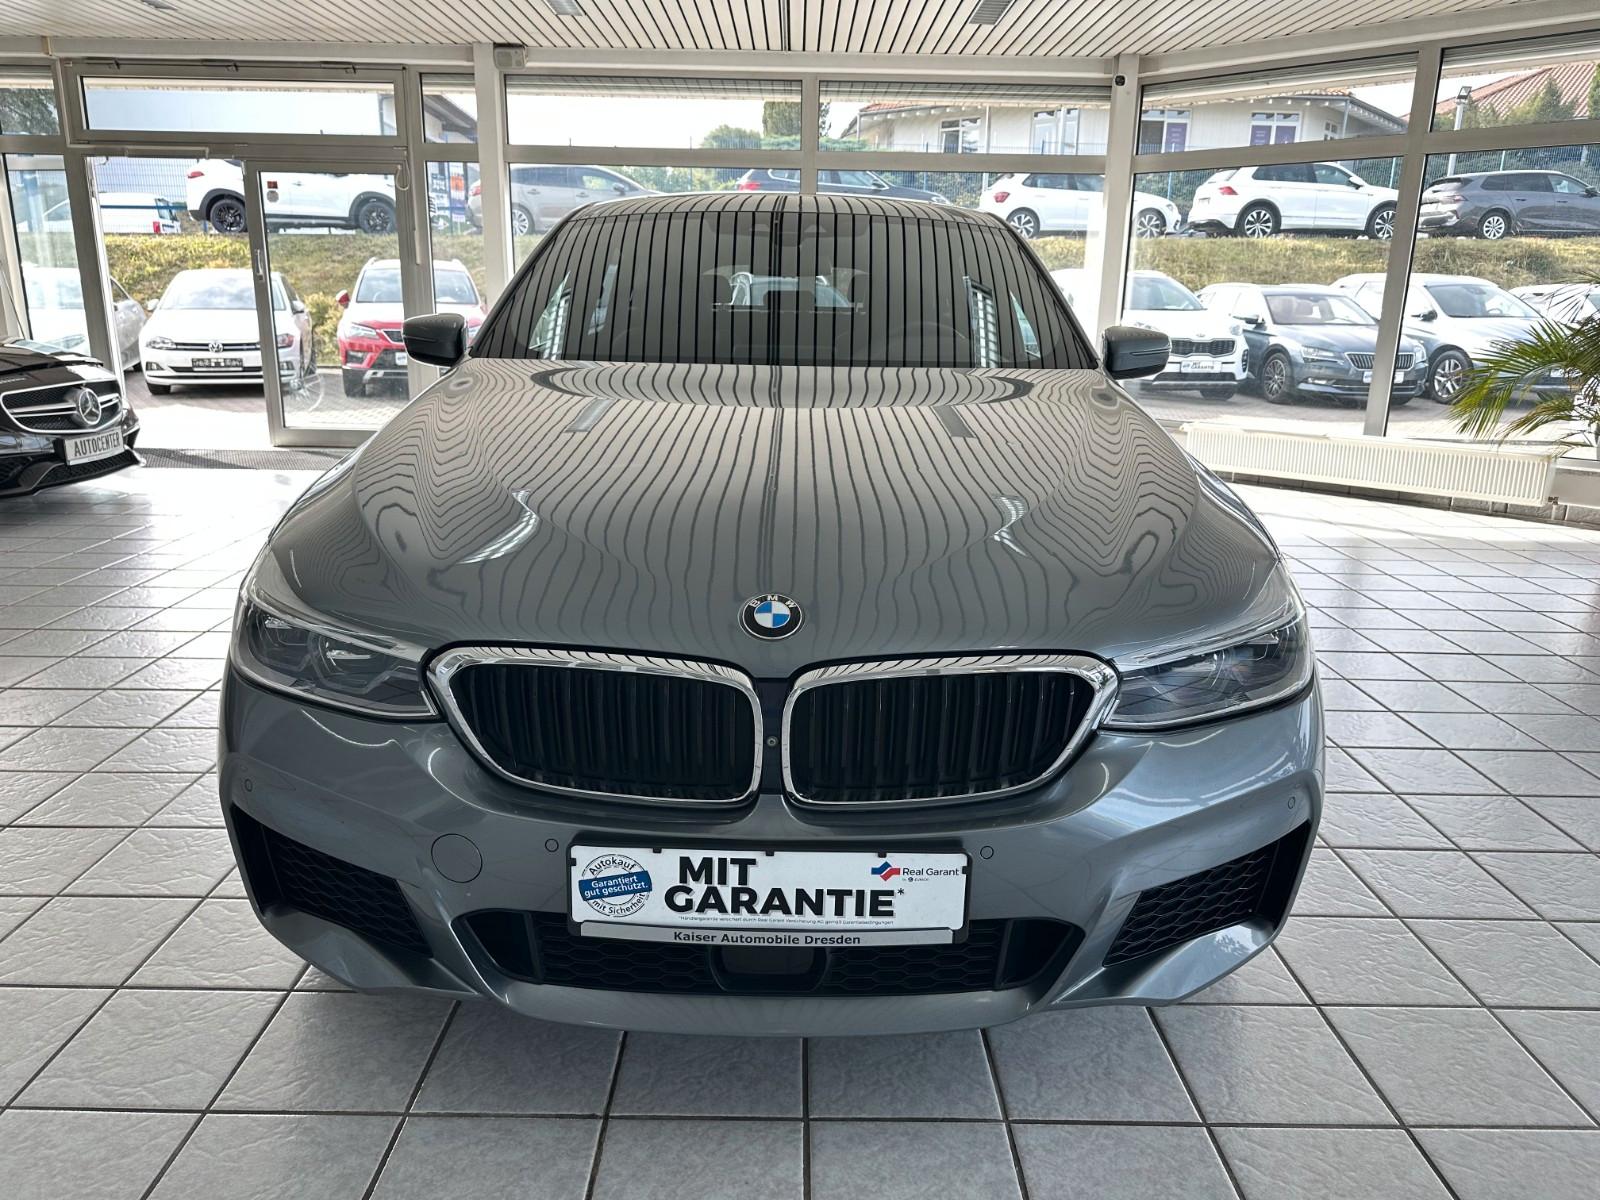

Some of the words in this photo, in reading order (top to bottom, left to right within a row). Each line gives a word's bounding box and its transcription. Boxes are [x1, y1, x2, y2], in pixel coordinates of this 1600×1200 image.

[74, 431, 121, 457] AUTOCENTER
[748, 594, 798, 608] BMW
[588, 856, 637, 876] Autokauf
[678, 856, 757, 886] MIT
[902, 867, 924, 876] Real
[925, 867, 960, 876] Garant
[591, 875, 638, 888] Garantiert
[584, 887, 601, 899] gut
[592, 900, 607, 912] mit
[608, 893, 646, 915] Sicherheit
[673, 931, 717, 943] Kaiser
[720, 932, 801, 946] Automobile
[804, 934, 861, 946] Dresden
